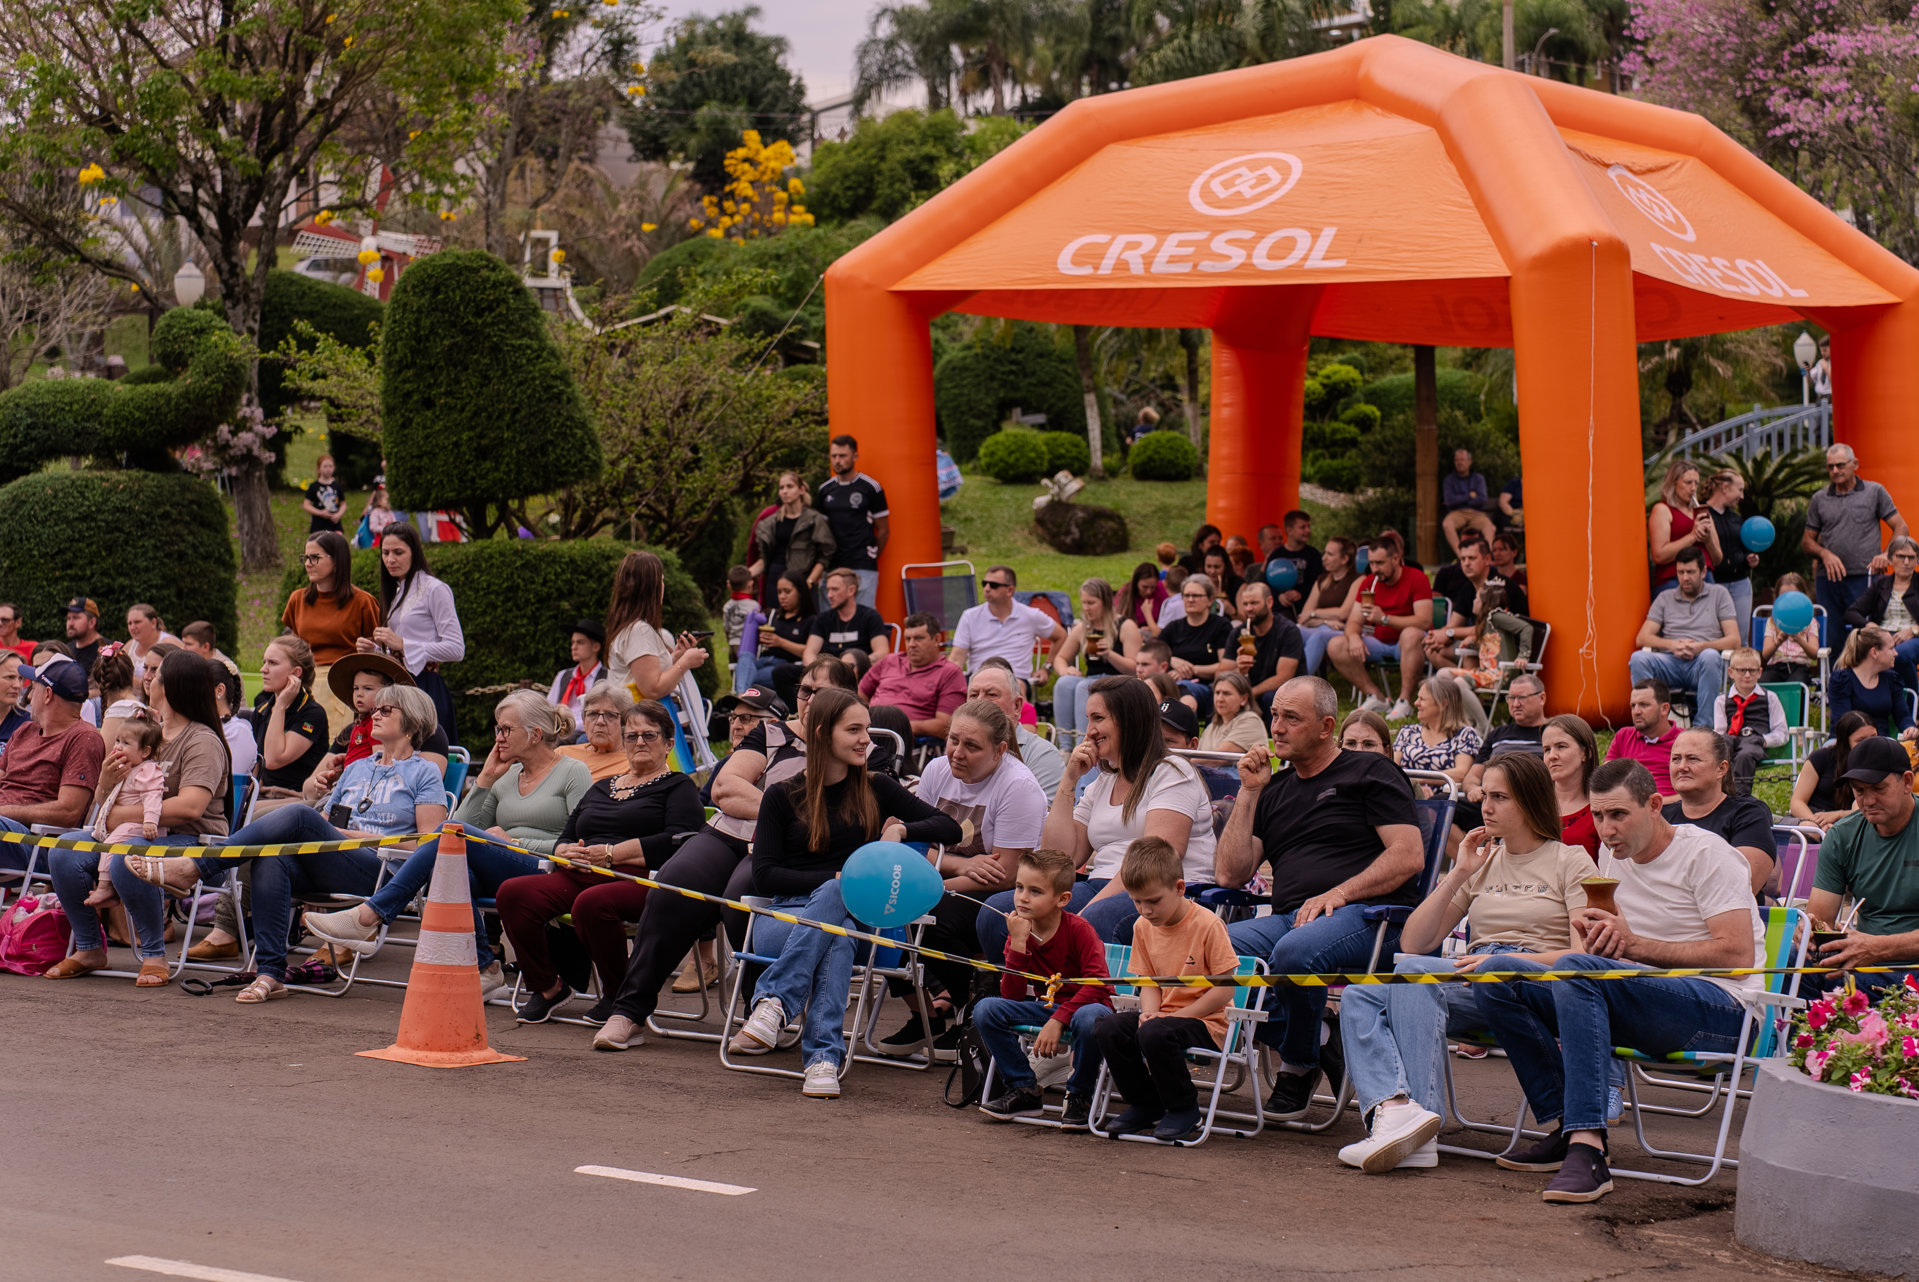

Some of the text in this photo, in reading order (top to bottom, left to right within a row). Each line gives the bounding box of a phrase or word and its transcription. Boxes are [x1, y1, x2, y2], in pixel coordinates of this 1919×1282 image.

[1057, 227, 1347, 275] CRESOL
[1650, 242, 1809, 298] CRESOL
[888, 864, 902, 905] SICOOB
